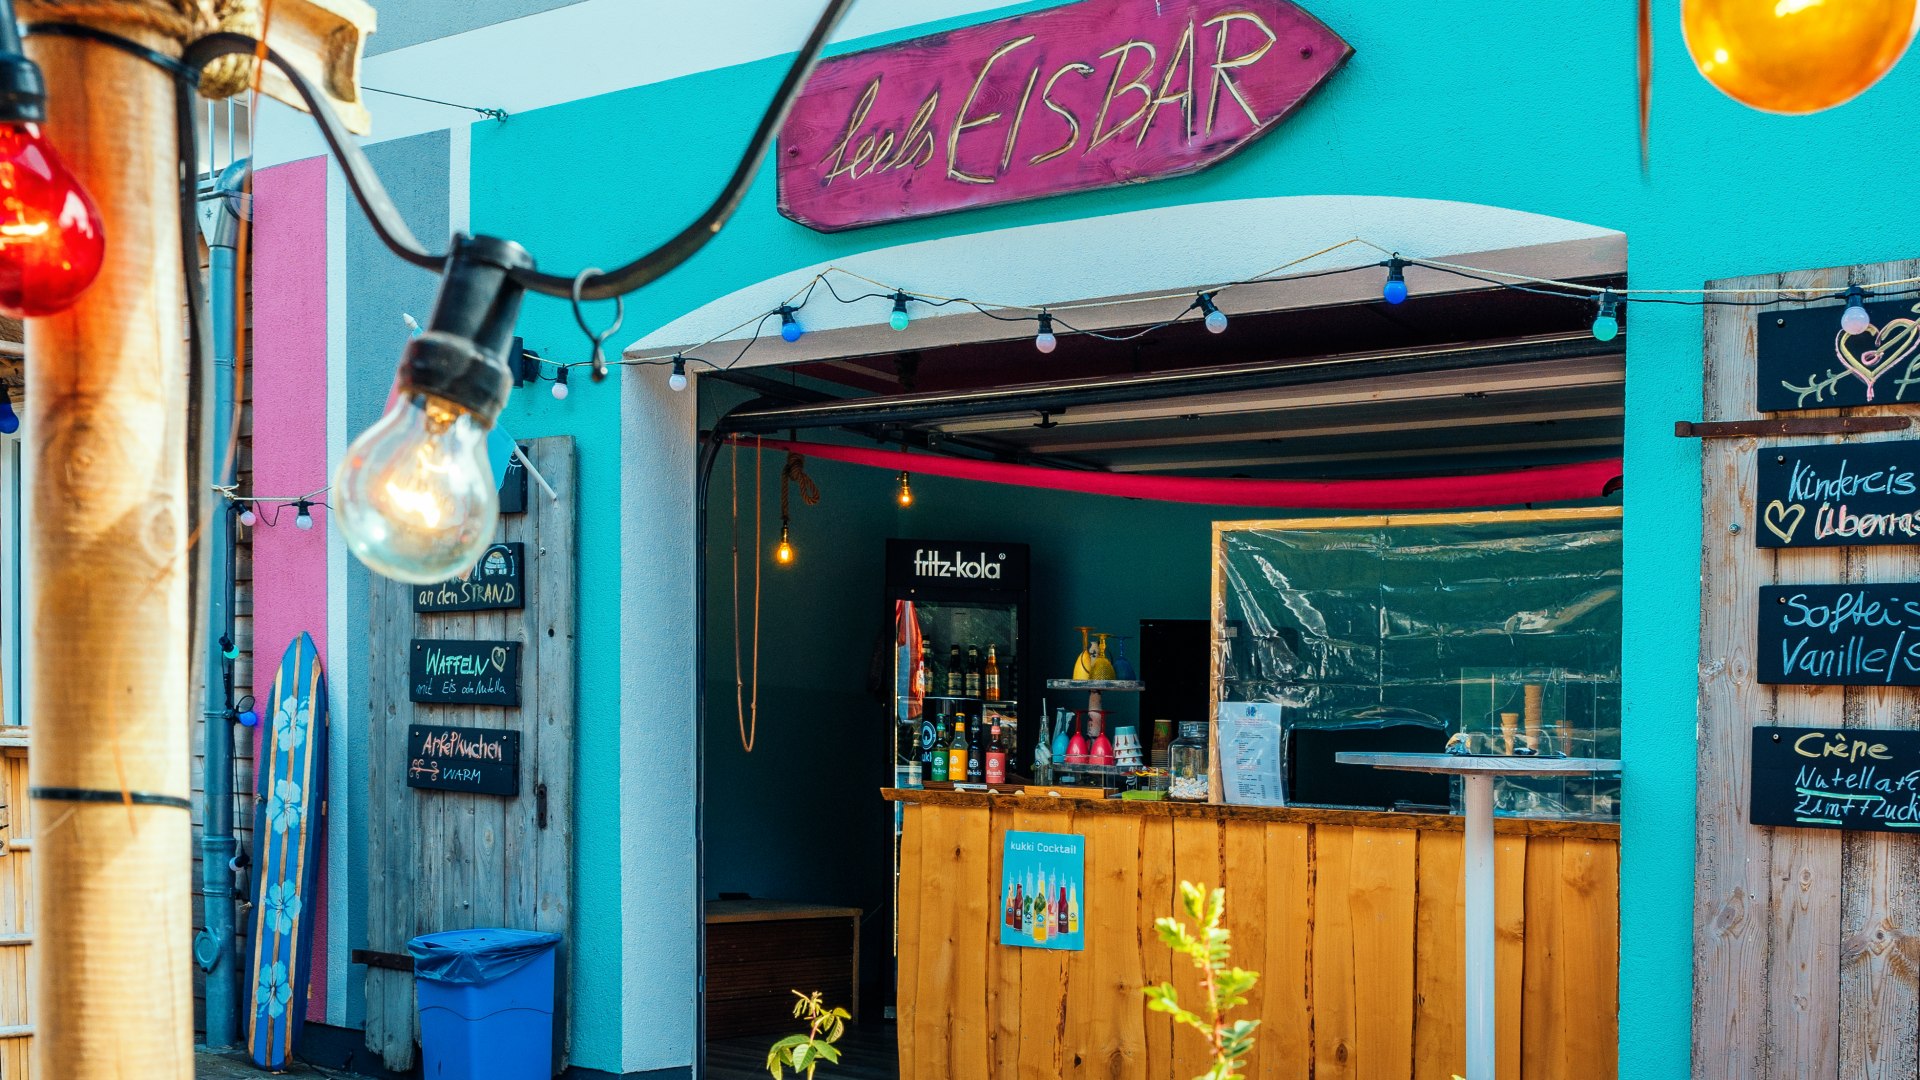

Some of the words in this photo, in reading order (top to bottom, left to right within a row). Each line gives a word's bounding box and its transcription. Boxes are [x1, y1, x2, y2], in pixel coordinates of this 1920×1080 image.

[946, 10, 1278, 185] EISBAR
[436, 583, 458, 605] den
[425, 647, 490, 676] WAFFELN
[443, 767, 481, 784] WARM
[1010, 841, 1035, 852] kukki
[1037, 843, 1077, 855] Cocktail
